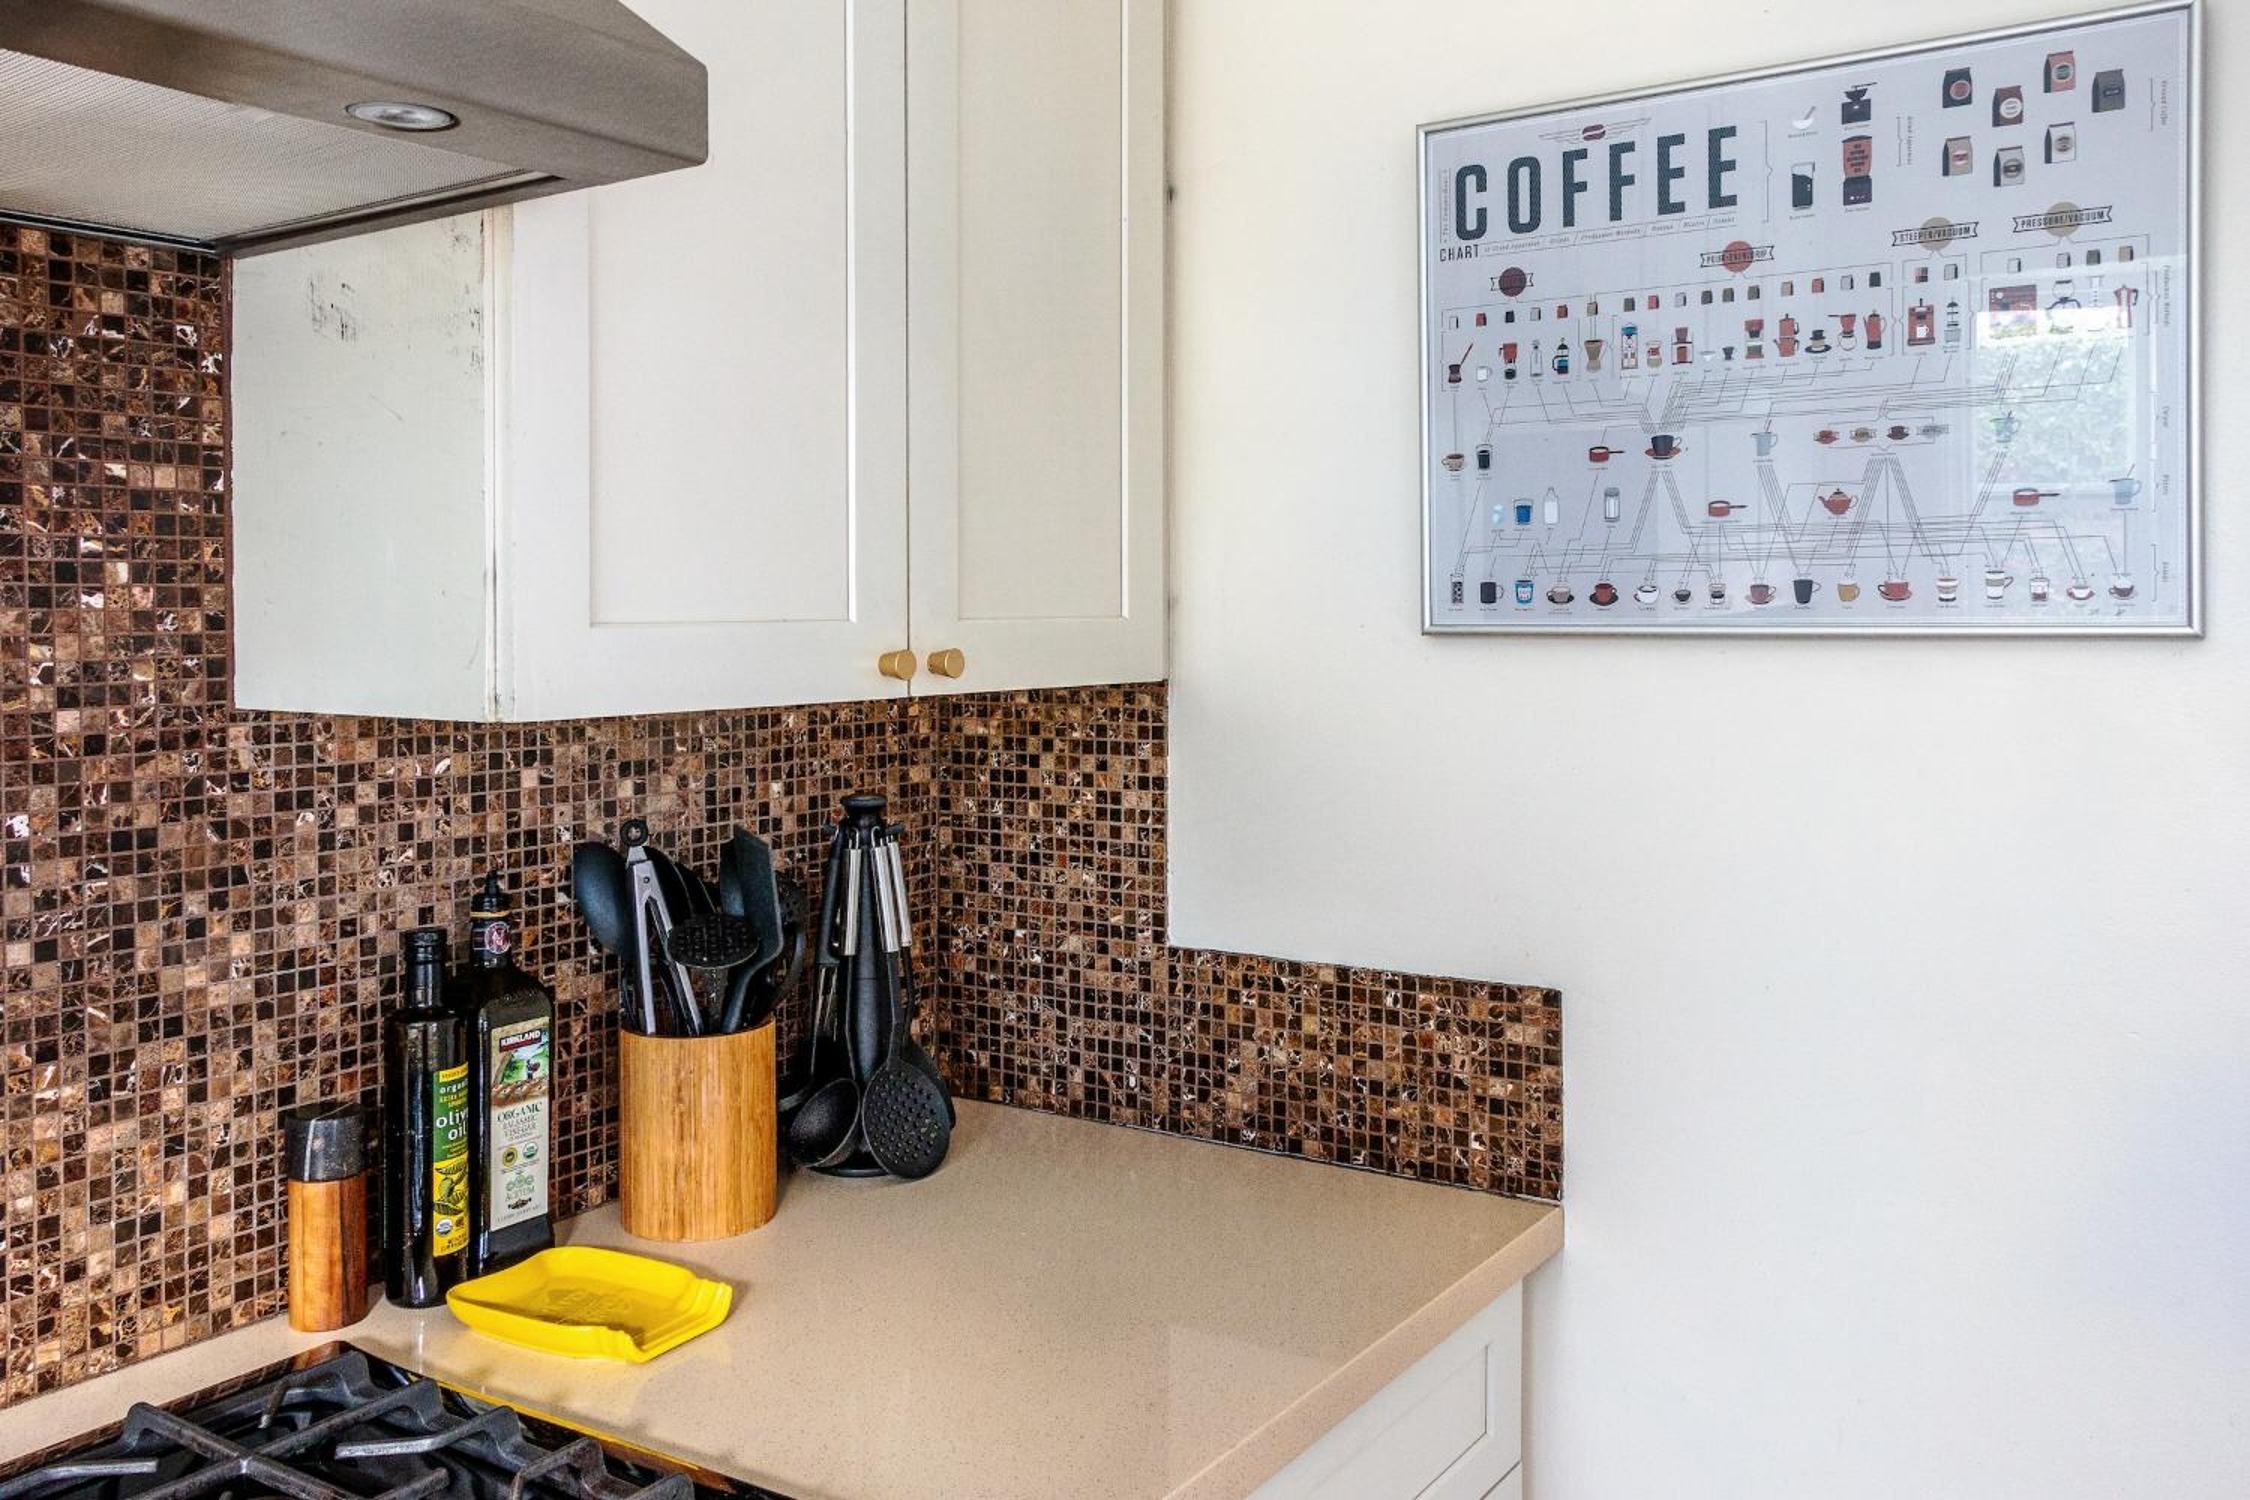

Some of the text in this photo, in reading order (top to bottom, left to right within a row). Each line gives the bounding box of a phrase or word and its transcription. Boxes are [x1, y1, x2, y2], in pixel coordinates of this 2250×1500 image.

[1455, 125, 1738, 240] COFFEE
[1440, 244, 1479, 263] CHART
[500, 1030, 541, 1048] KIRKLAND
[497, 1101, 543, 1122] ORGANIC
[448, 1121, 467, 1140] oil
